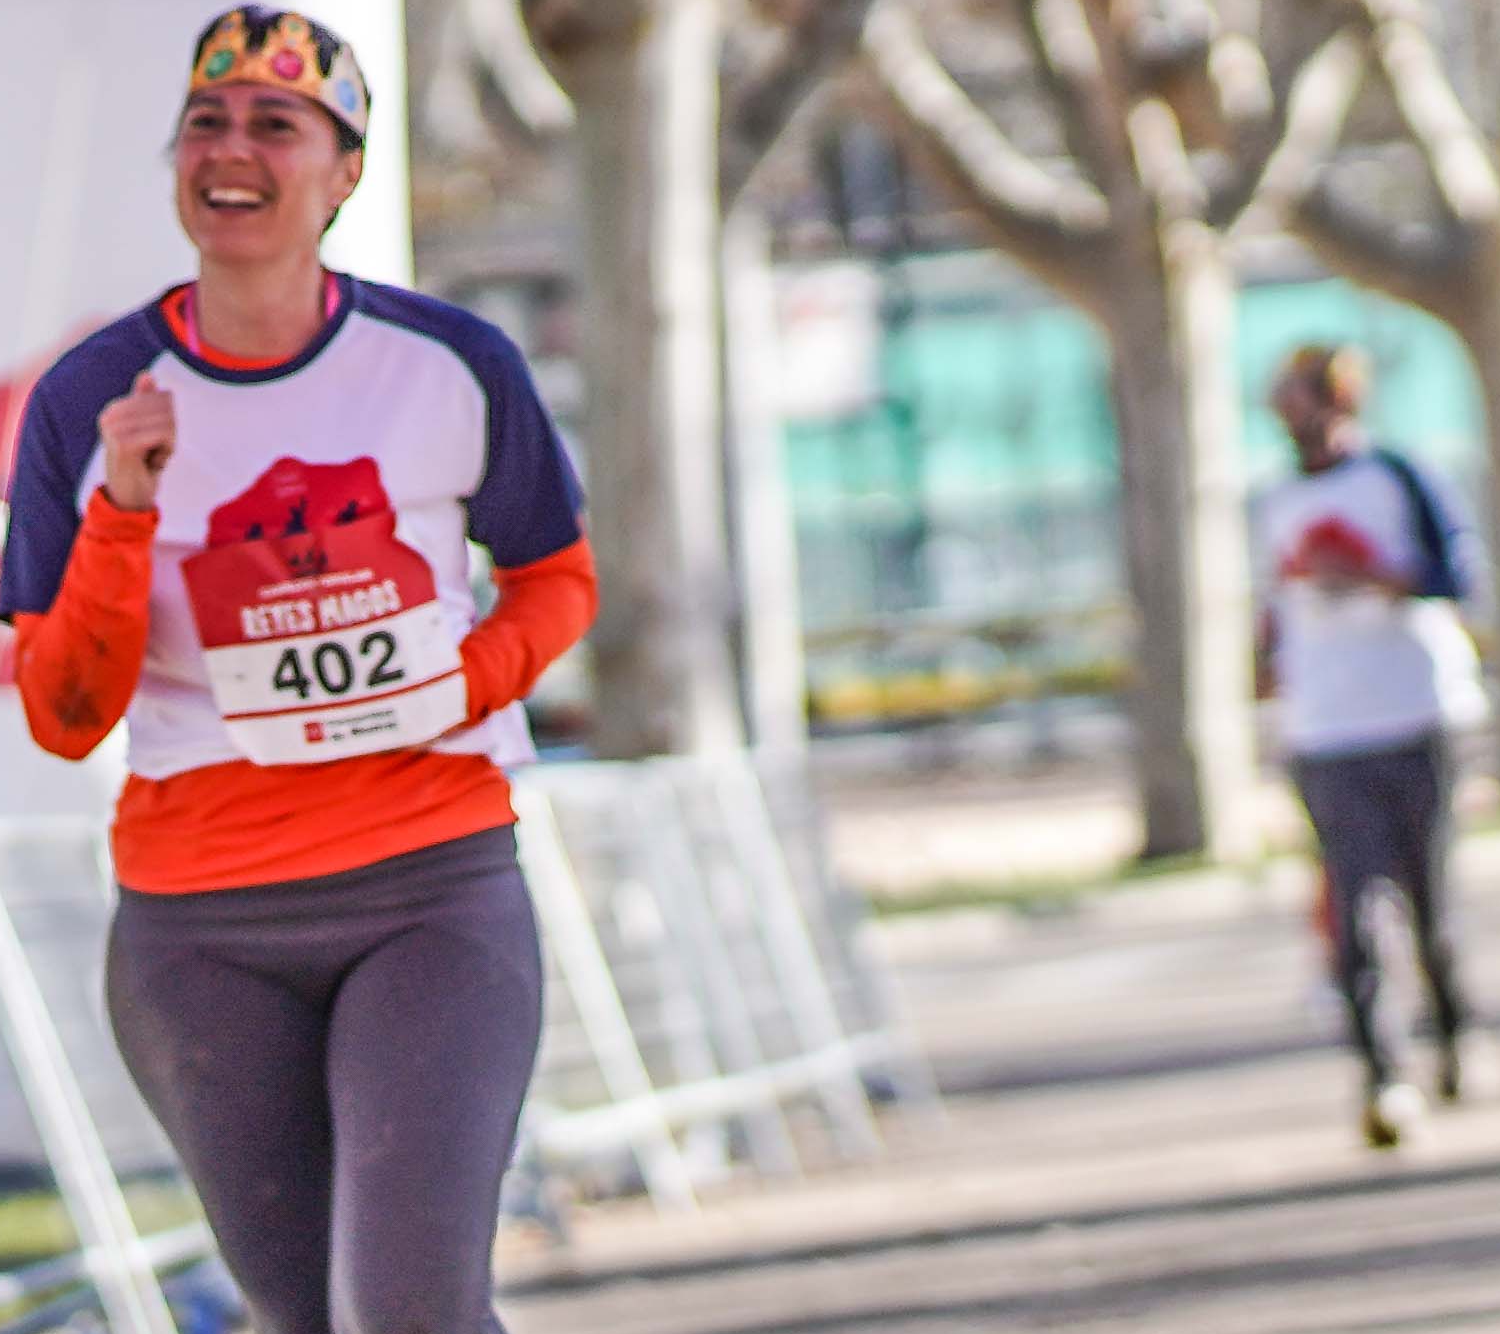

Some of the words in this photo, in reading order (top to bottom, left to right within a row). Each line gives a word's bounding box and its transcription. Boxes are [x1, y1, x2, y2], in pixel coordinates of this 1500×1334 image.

[240, 597, 317, 640] REYES
[317, 578, 401, 630] MAGOS
[273, 629, 405, 699] 402
